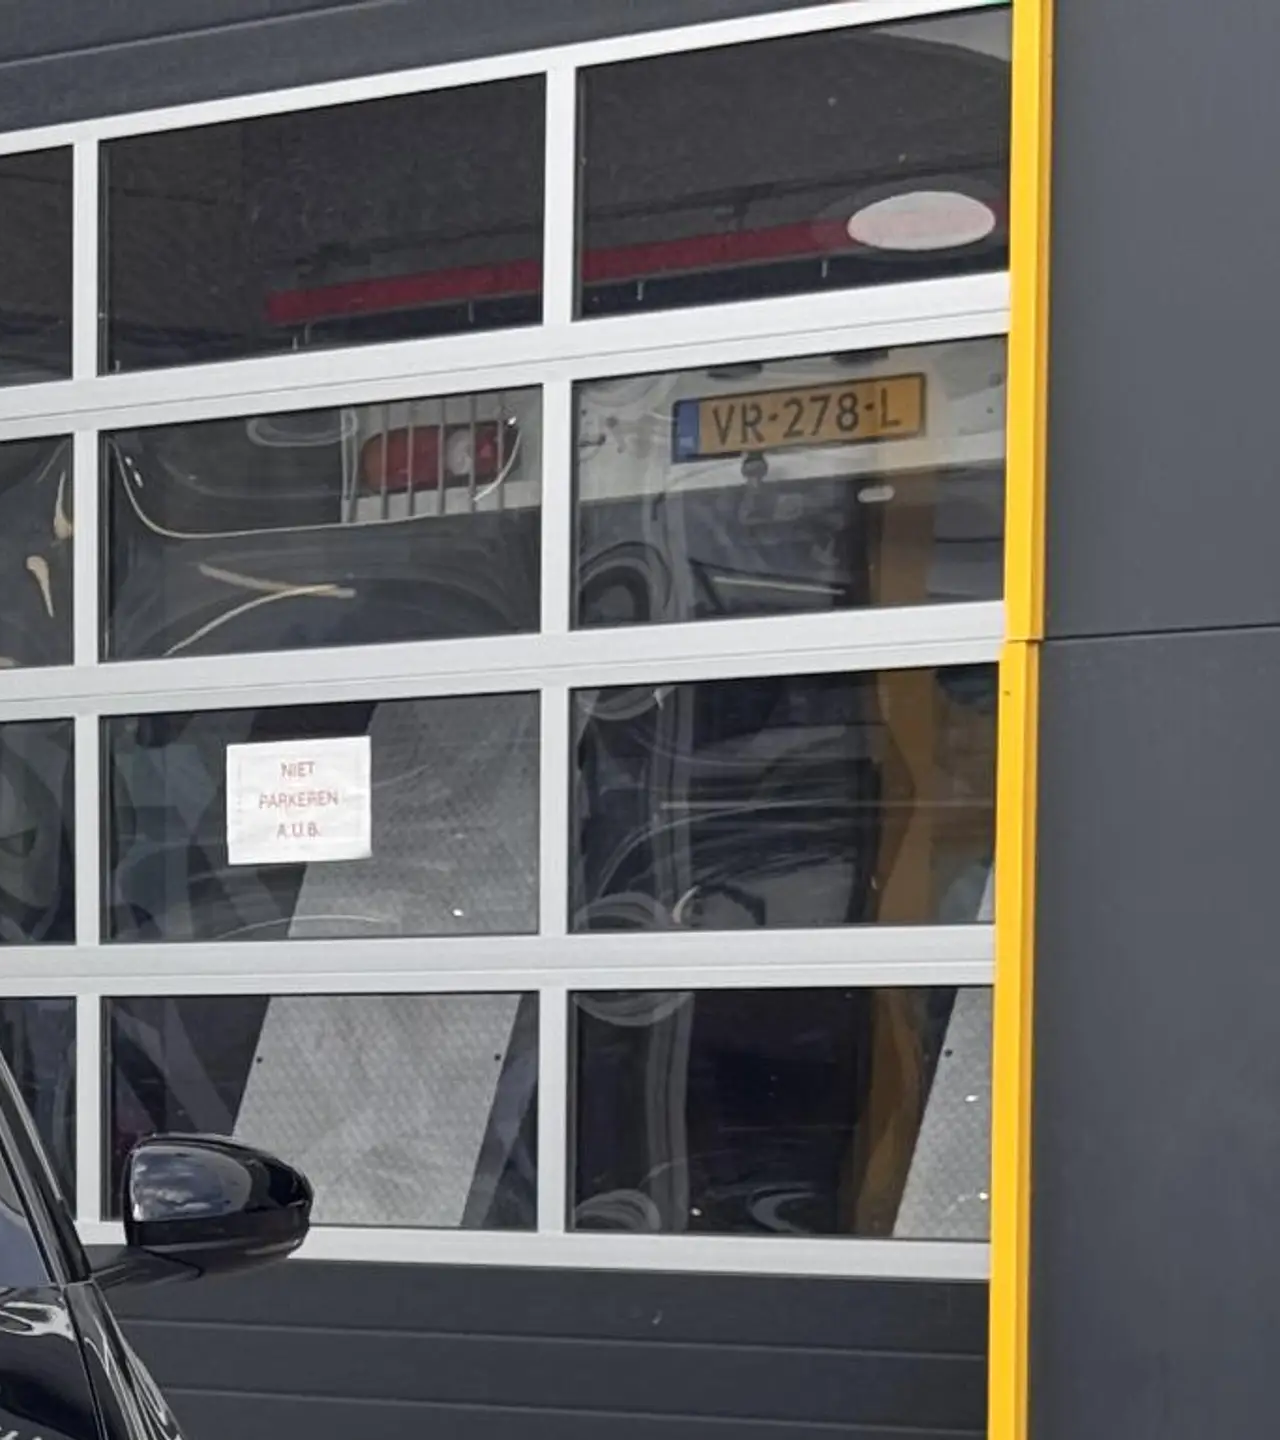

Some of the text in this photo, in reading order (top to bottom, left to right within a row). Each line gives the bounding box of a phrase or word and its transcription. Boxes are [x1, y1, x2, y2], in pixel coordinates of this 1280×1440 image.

[712, 388, 901, 445] VR-278-L
[281, 761, 316, 777] NIET
[258, 790, 339, 809] PARKEREN
